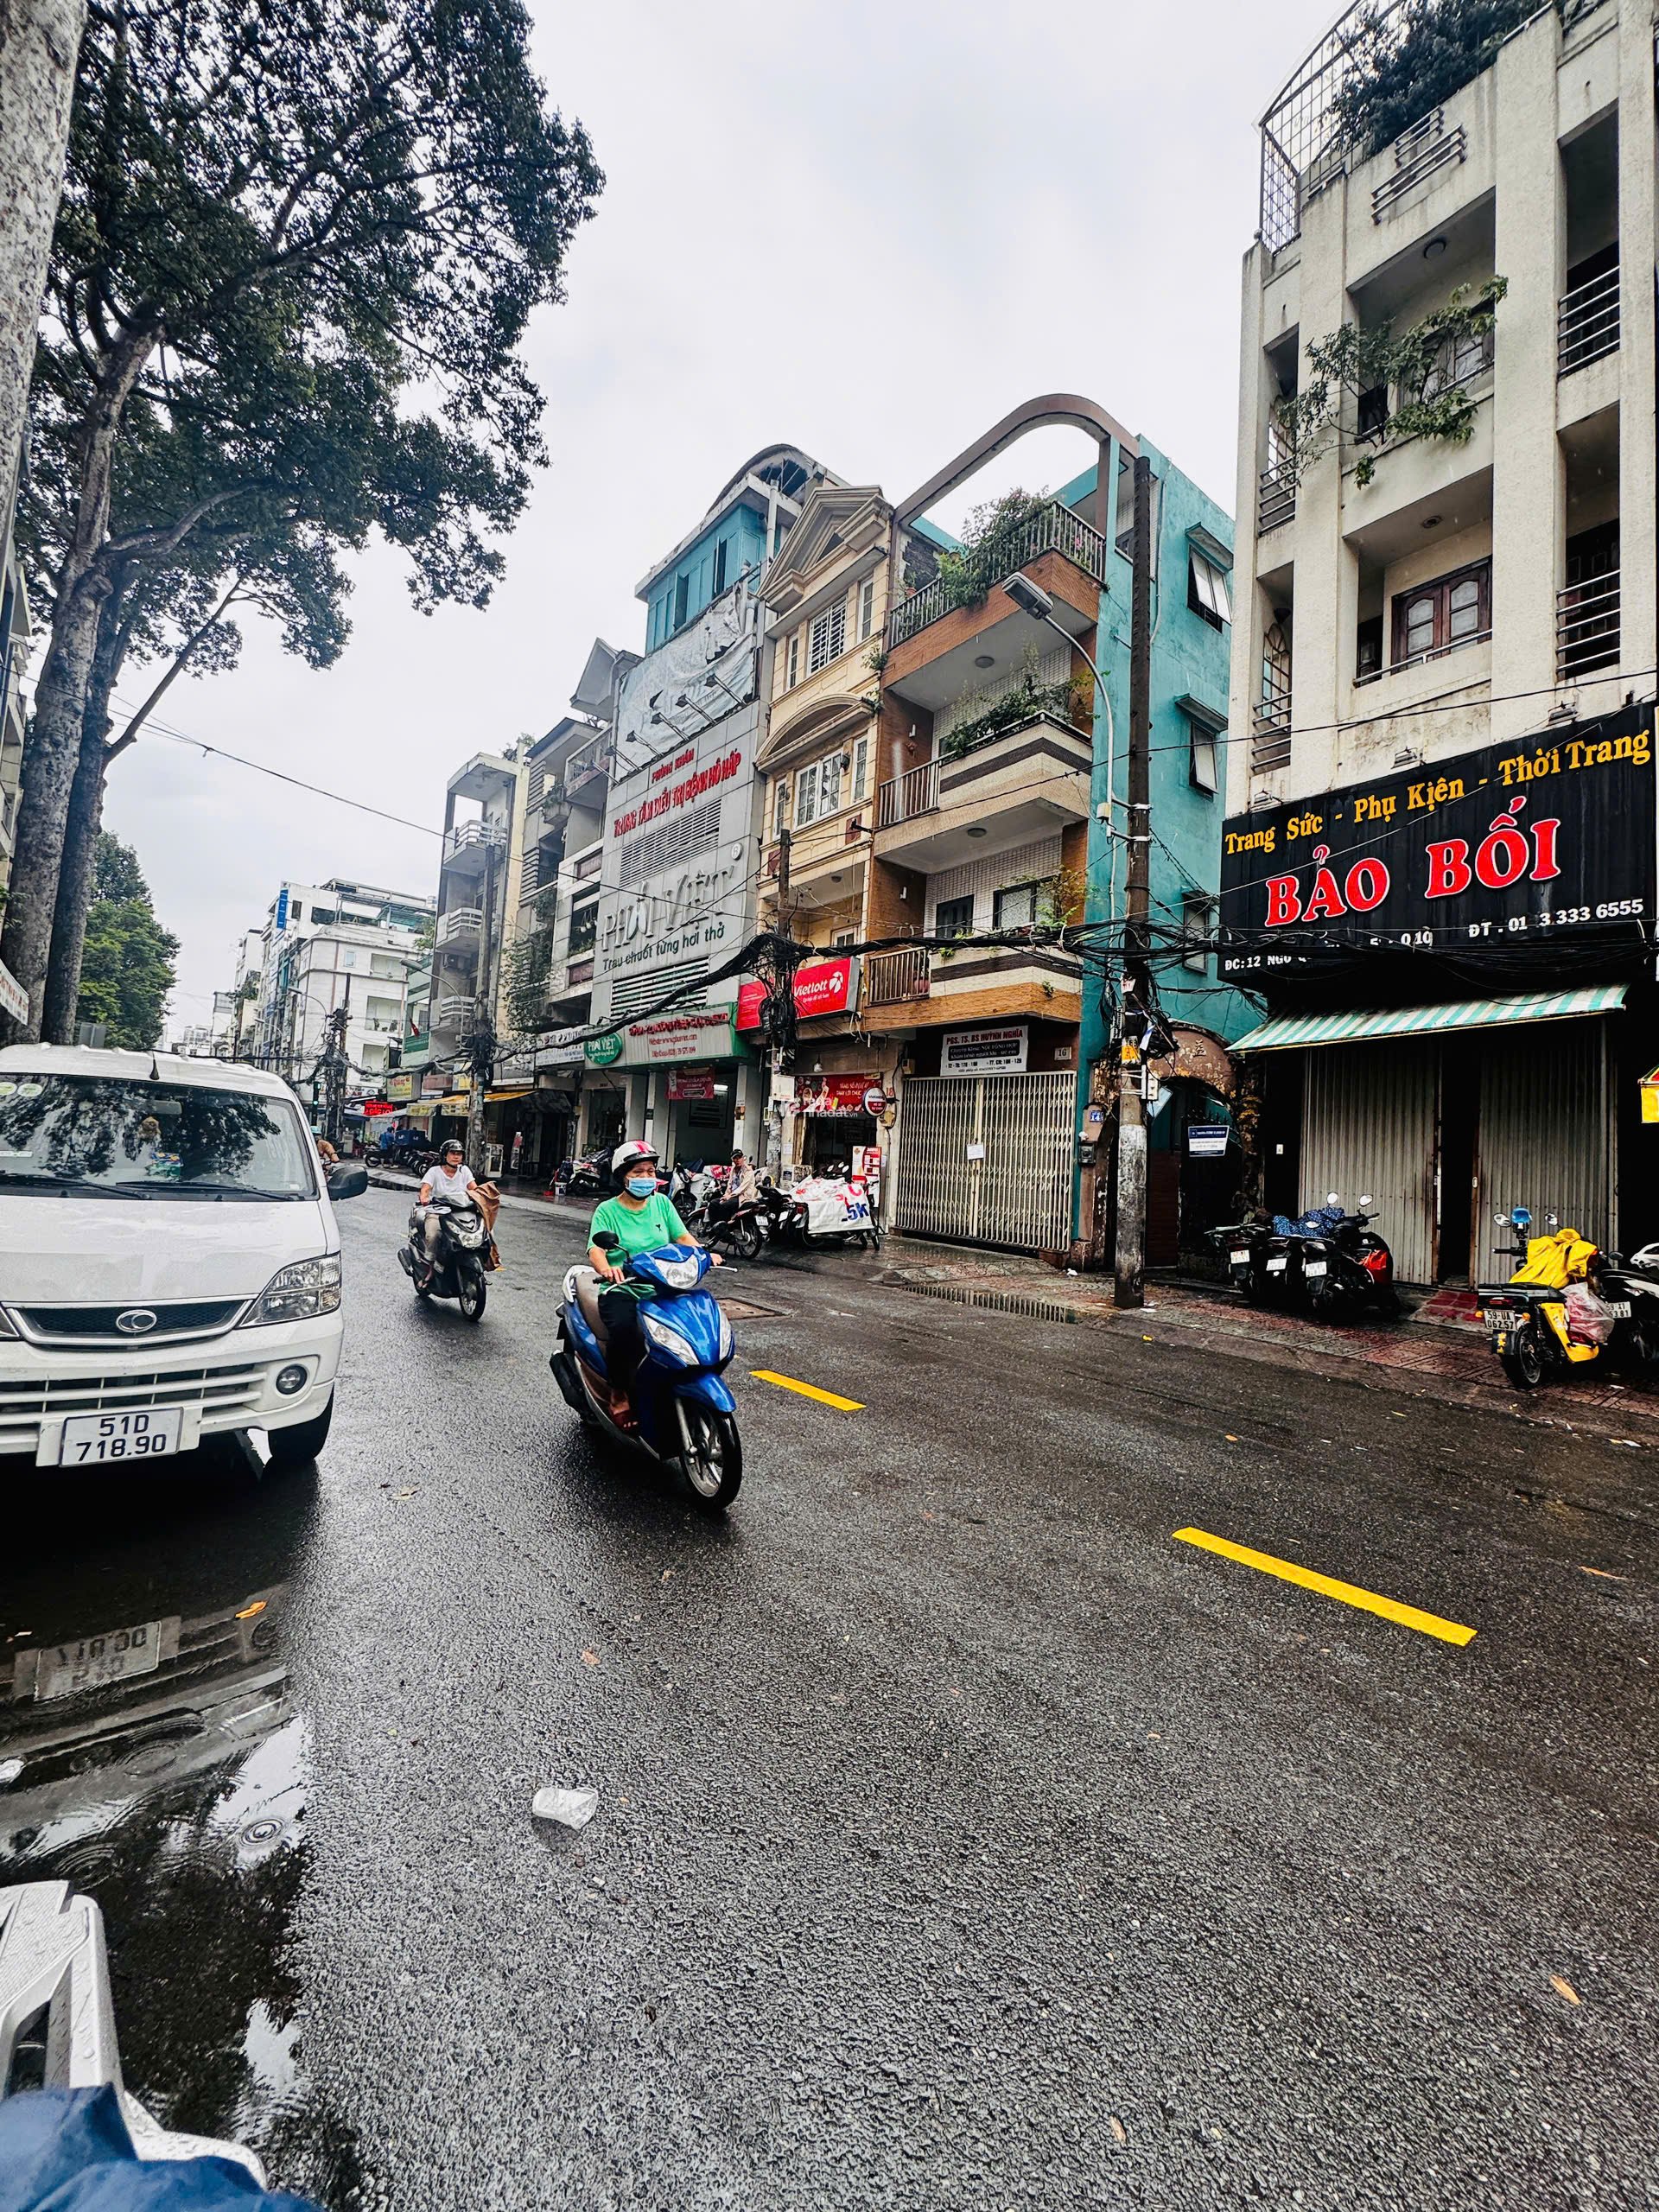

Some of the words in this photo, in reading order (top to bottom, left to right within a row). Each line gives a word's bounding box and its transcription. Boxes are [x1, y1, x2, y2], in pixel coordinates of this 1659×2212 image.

[1225, 826, 1275, 855] Trang
[1287, 812, 1323, 841] Sức
[1354, 795, 1396, 823] Phụ
[1498, 748, 1560, 786] Thời
[1565, 729, 1650, 770] Trang
[614, 810, 637, 838] TRUNG
[638, 800, 652, 826] TÂM
[1264, 844, 1390, 927] BẢO
[1424, 795, 1561, 899] BỐI
[664, 865, 734, 931] VIỆT
[1596, 899, 1644, 918] 6555
[603, 958, 623, 970] Trau
[625, 943, 652, 965] chuốt
[656, 940, 679, 956] từng
[683, 931, 699, 949] hơi
[704, 921, 725, 942] thở
[794, 979, 828, 996] Vietlott
[981, 1032, 1001, 1041] HUỲNH
[1002, 1028, 1023, 1039] NGHĨA
[886, 1087, 893, 1096] 18
[1488, 1311, 1511, 1320] 59-UA
[99, 1414, 149, 1437] 51D
[76, 1433, 167, 1462] 718.90
